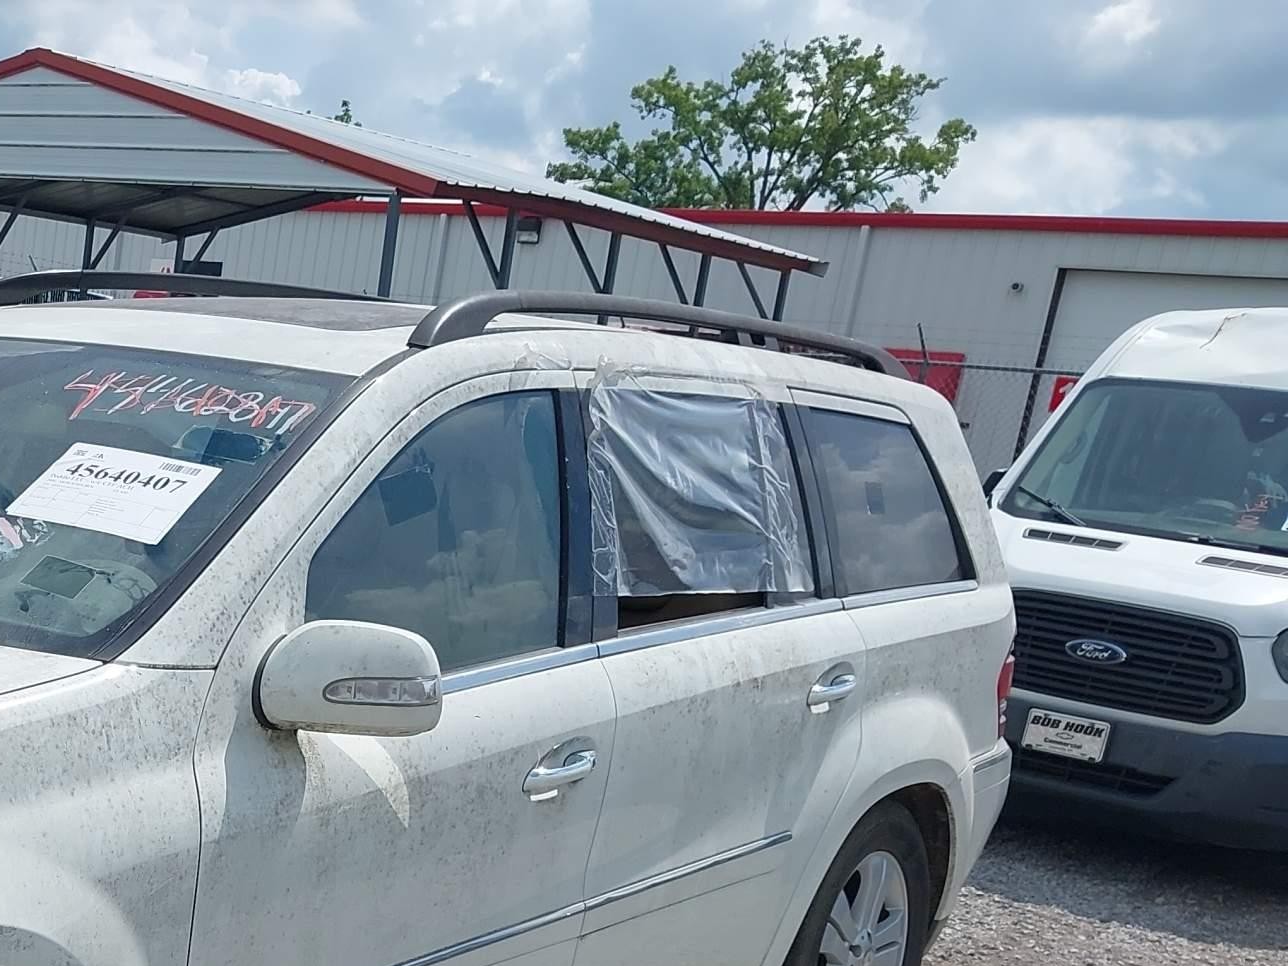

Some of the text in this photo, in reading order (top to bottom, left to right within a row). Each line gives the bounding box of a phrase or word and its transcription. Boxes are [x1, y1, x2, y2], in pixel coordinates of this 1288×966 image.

[66, 463, 188, 494] 45640407
[1076, 642, 1111, 659] Ford
[1030, 715, 1105, 738] BOB HOOK
